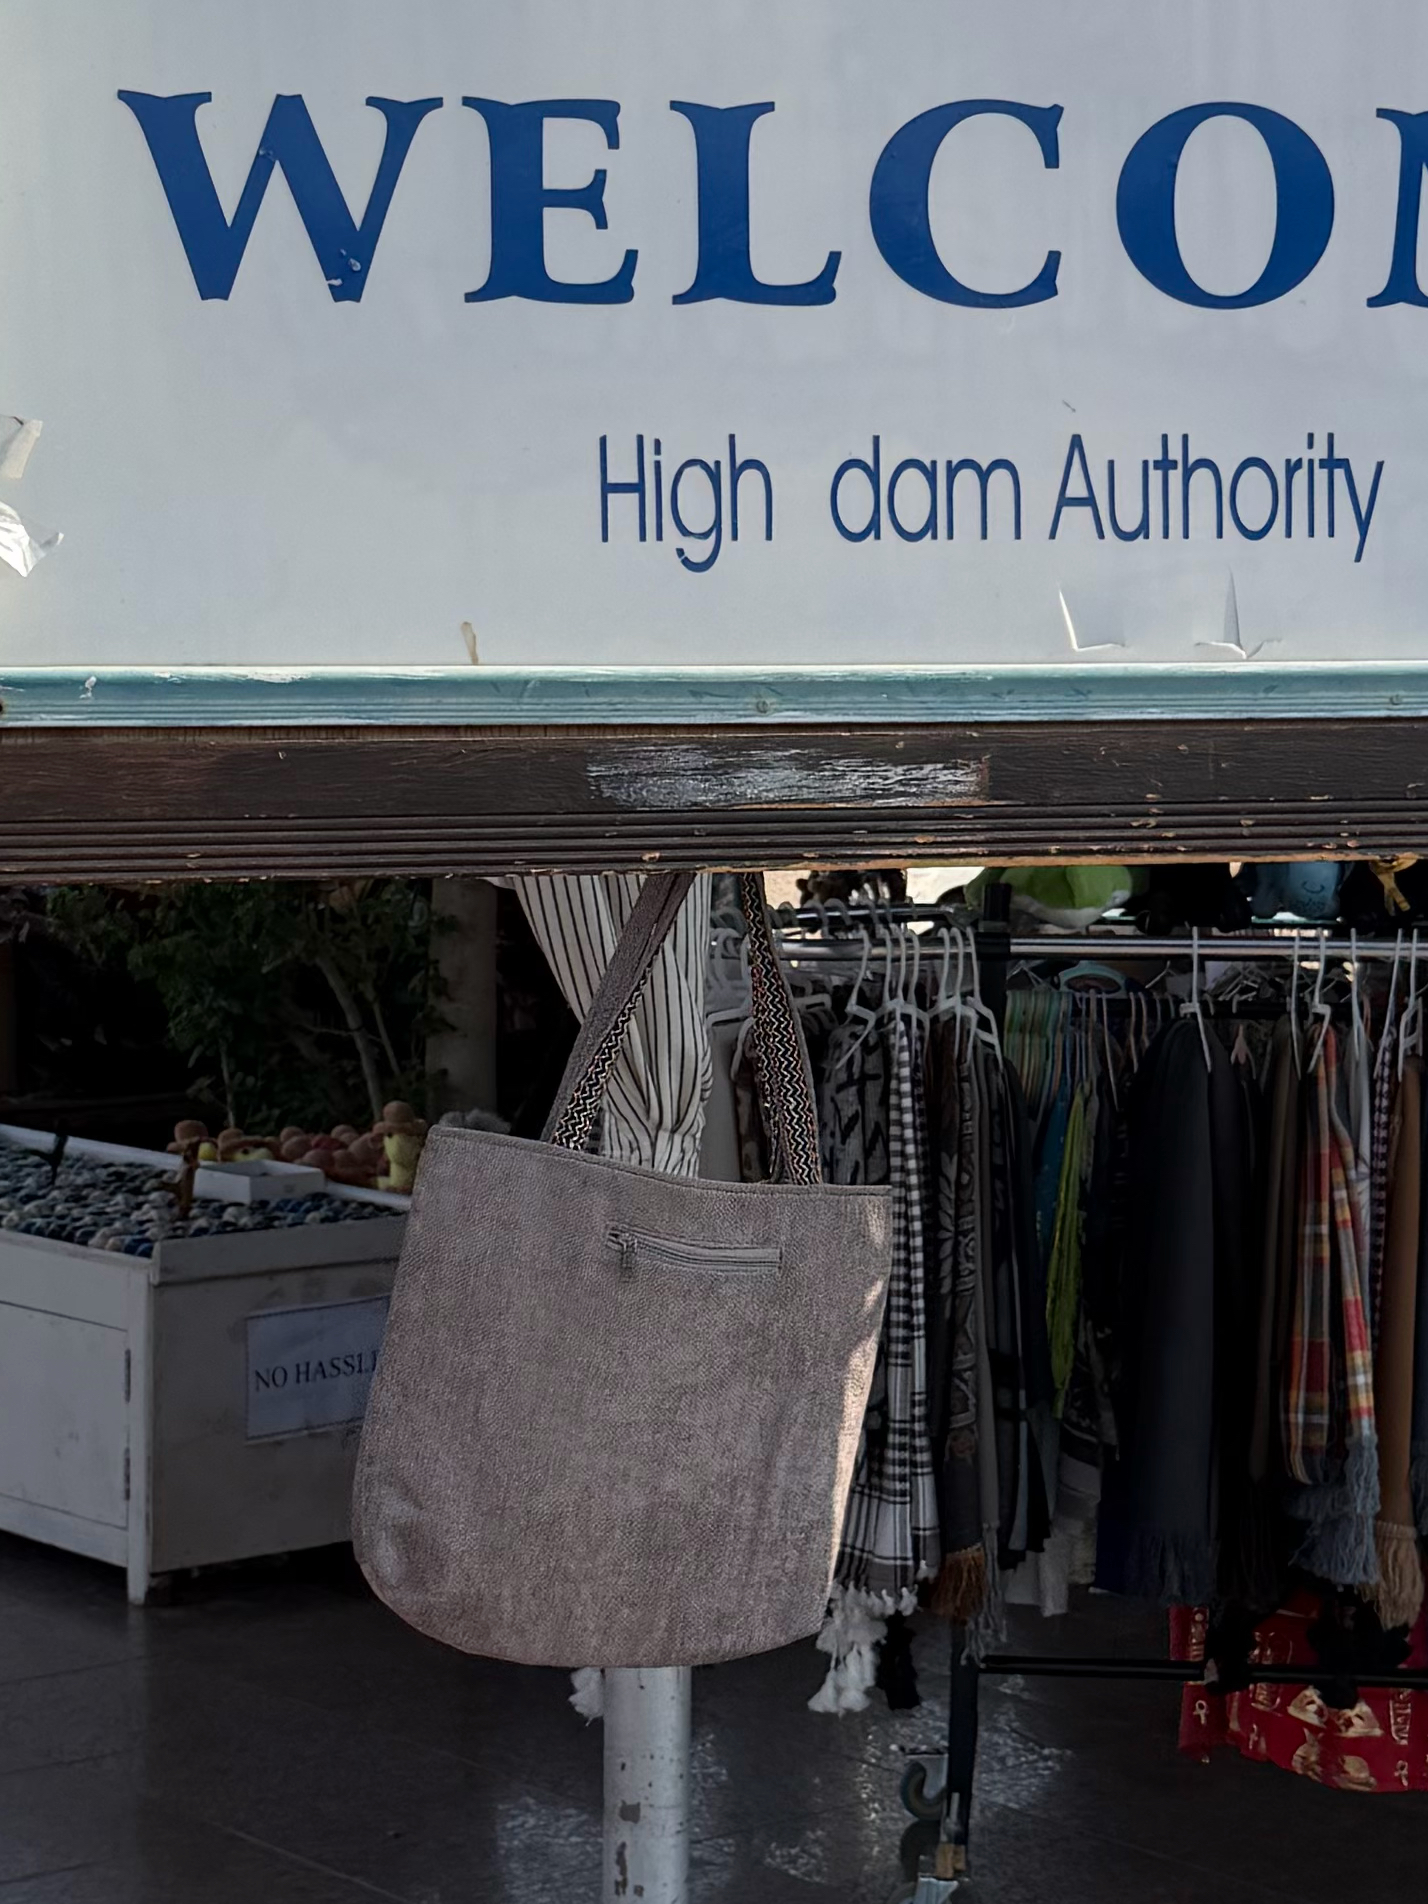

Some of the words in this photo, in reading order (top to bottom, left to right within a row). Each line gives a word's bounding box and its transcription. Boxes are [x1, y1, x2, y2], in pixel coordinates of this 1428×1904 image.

[598, 433, 774, 575] High
[829, 434, 1023, 544] dam
[1047, 431, 1386, 564] Authority
[255, 1365, 288, 1392] NO
